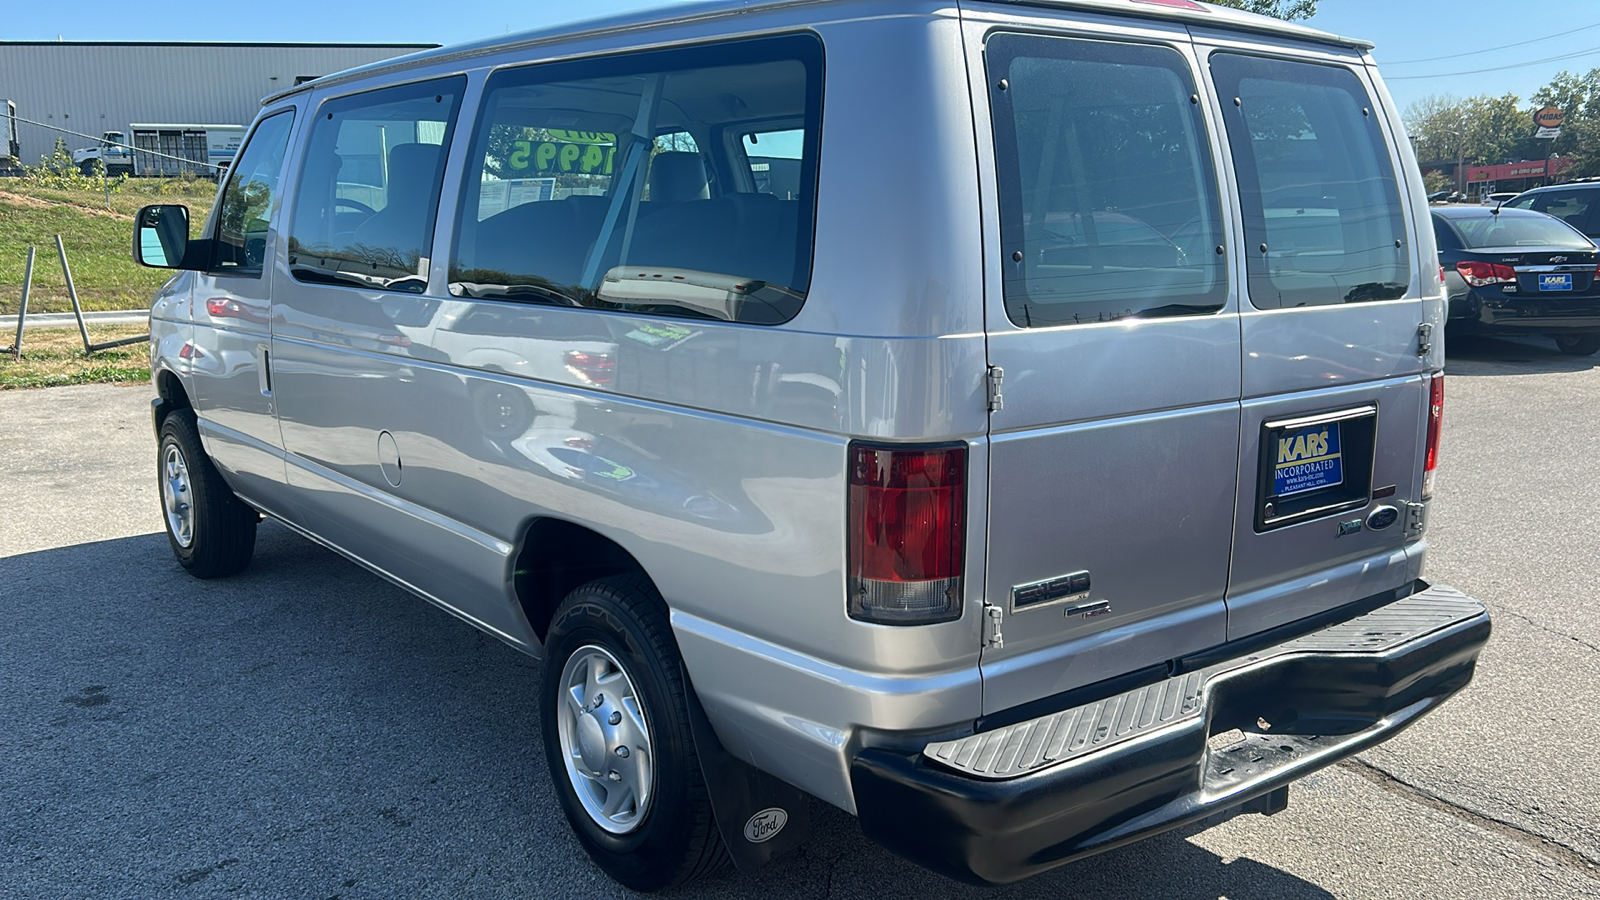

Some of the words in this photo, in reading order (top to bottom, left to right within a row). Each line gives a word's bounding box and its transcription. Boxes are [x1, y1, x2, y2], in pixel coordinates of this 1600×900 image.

[1539, 112, 1563, 120] MIDAS
[1544, 276, 1566, 284] KARS
[1278, 431, 1329, 463] KARS
[1275, 459, 1334, 480] INCORPORATED
[1286, 472, 1325, 485] www.kars-inc.com
[1284, 482, 1306, 492] PLEASANT
[753, 814, 778, 838] Ford
